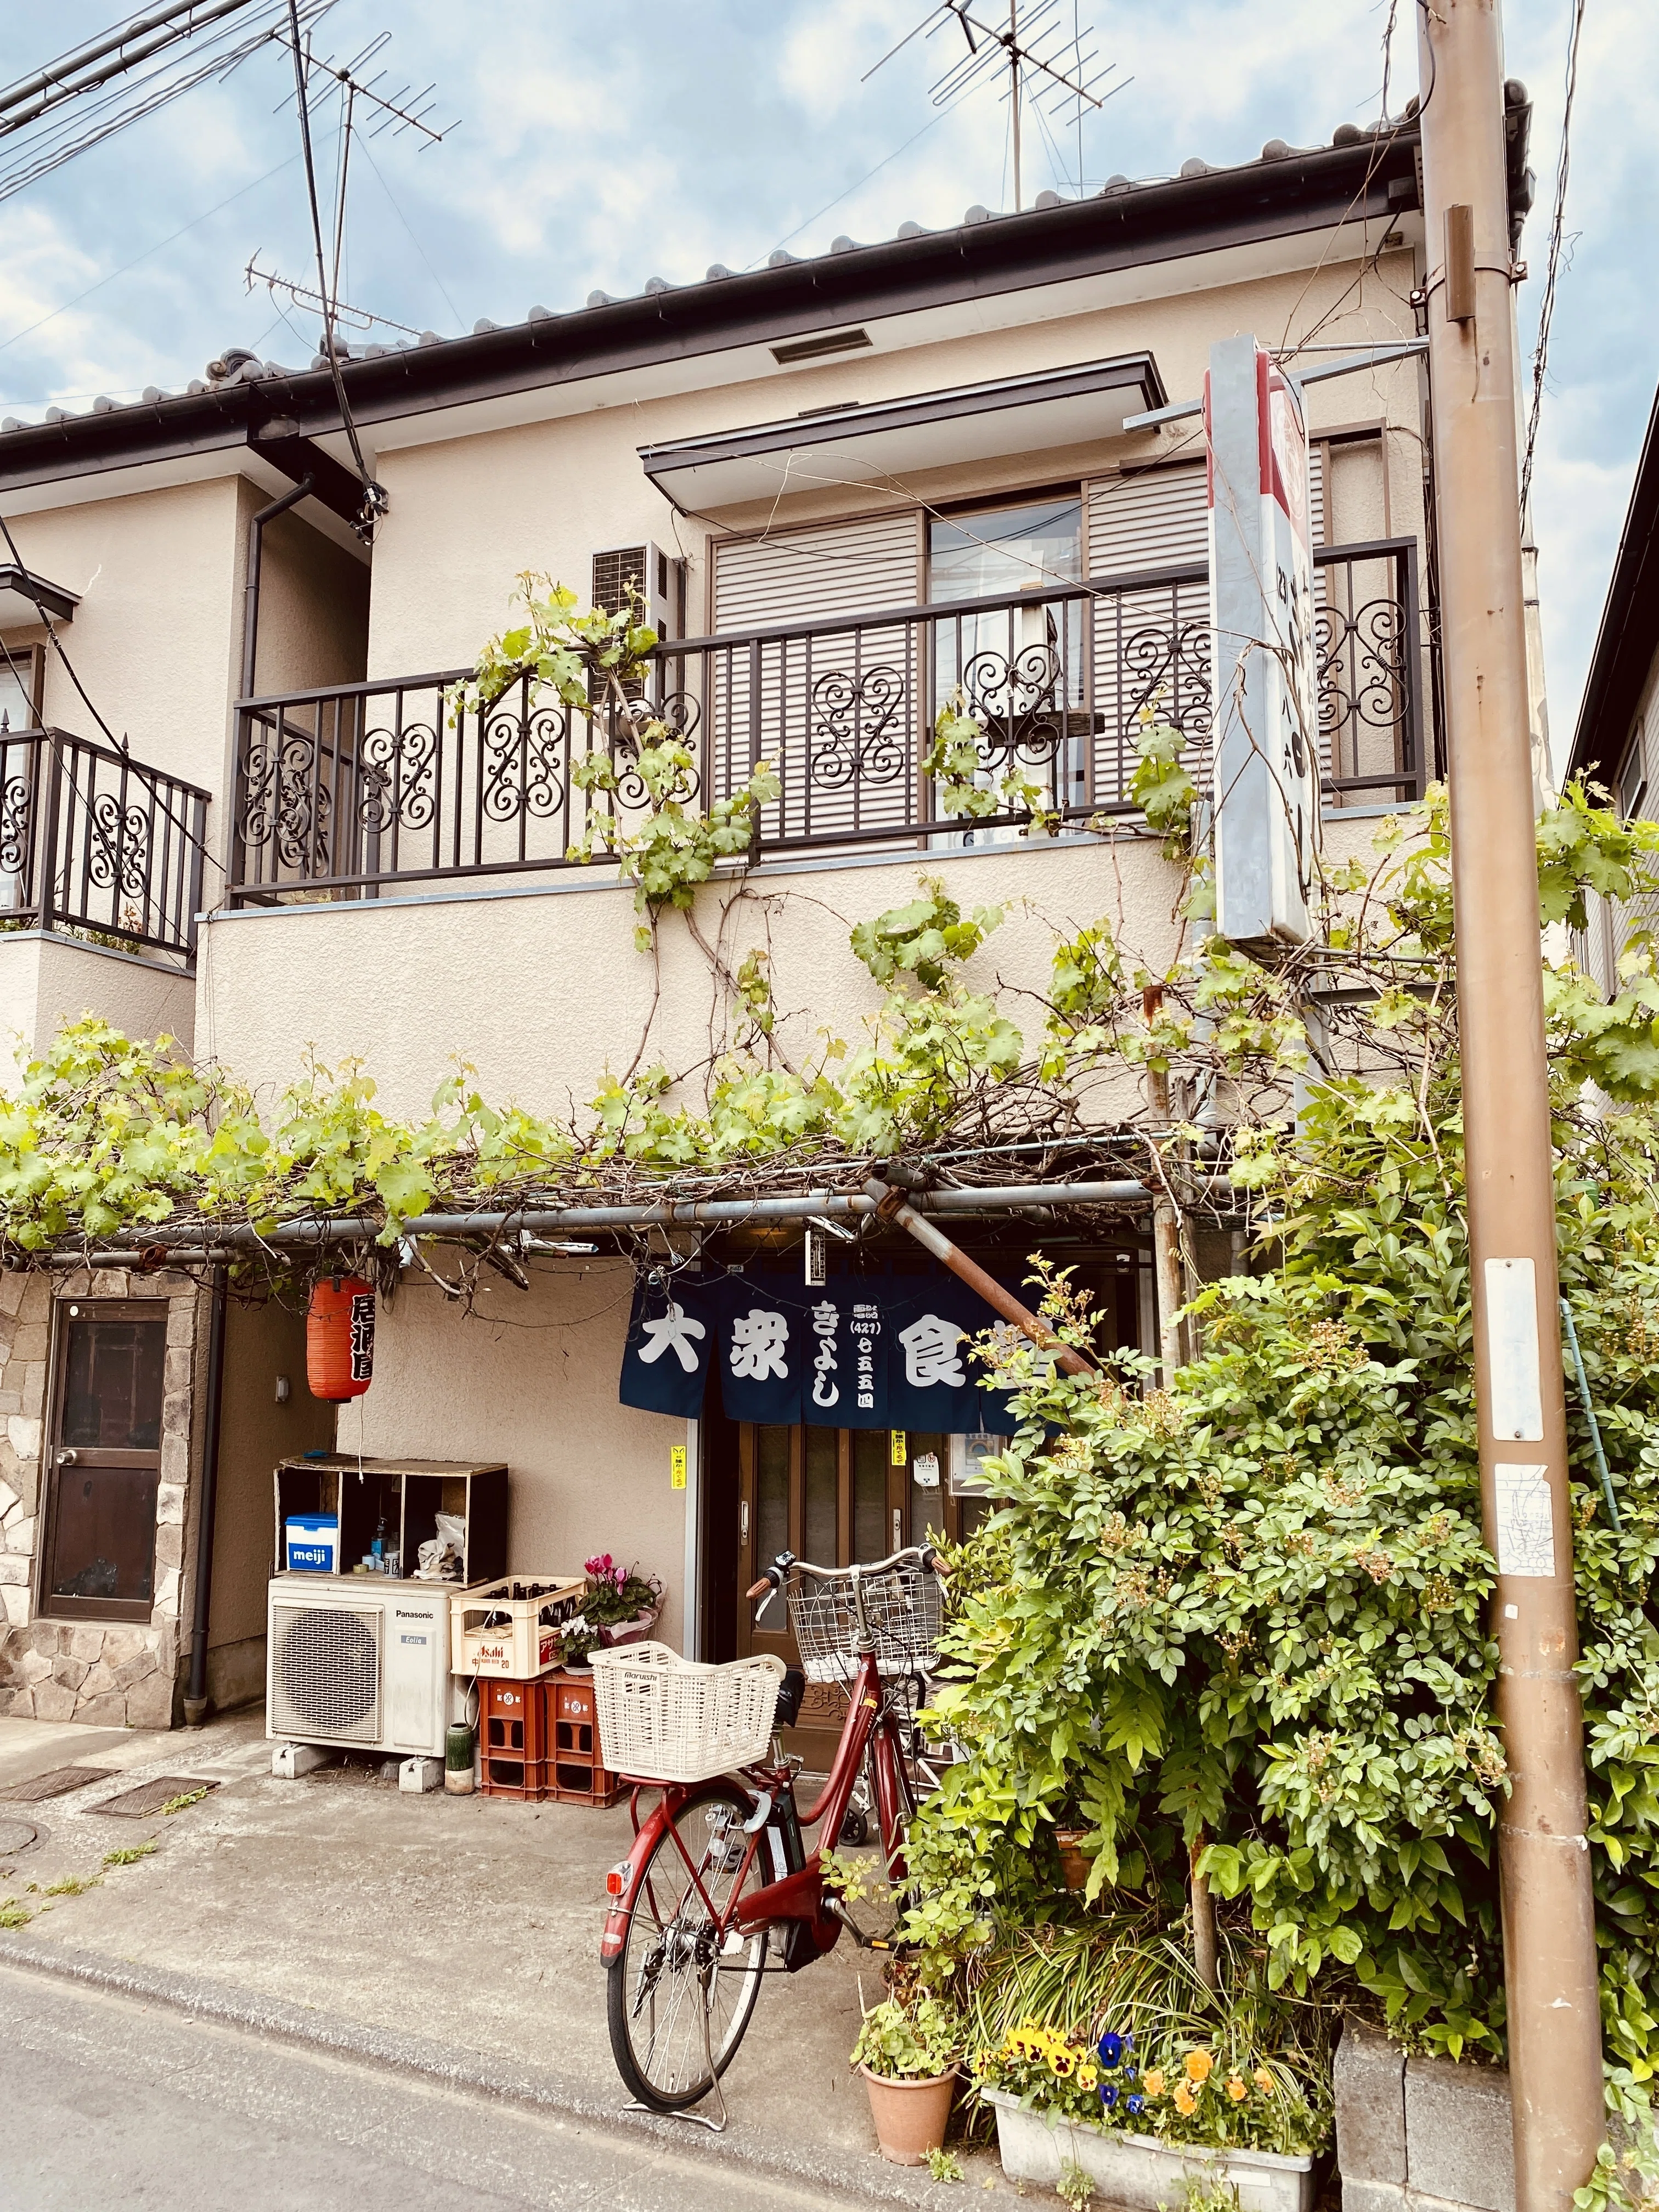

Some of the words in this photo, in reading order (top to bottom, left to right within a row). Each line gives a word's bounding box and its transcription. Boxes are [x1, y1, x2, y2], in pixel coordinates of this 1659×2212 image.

[811, 1300, 839, 1407] きよし
[294, 1549, 325, 1565] meiji
[396, 1610, 434, 1619] Panasonic
[405, 1636, 422, 1644] Eolia
[477, 1645, 504, 1658] Asahi
[472, 1657, 479, 1667] 中
[501, 1660, 509, 1669] 20
